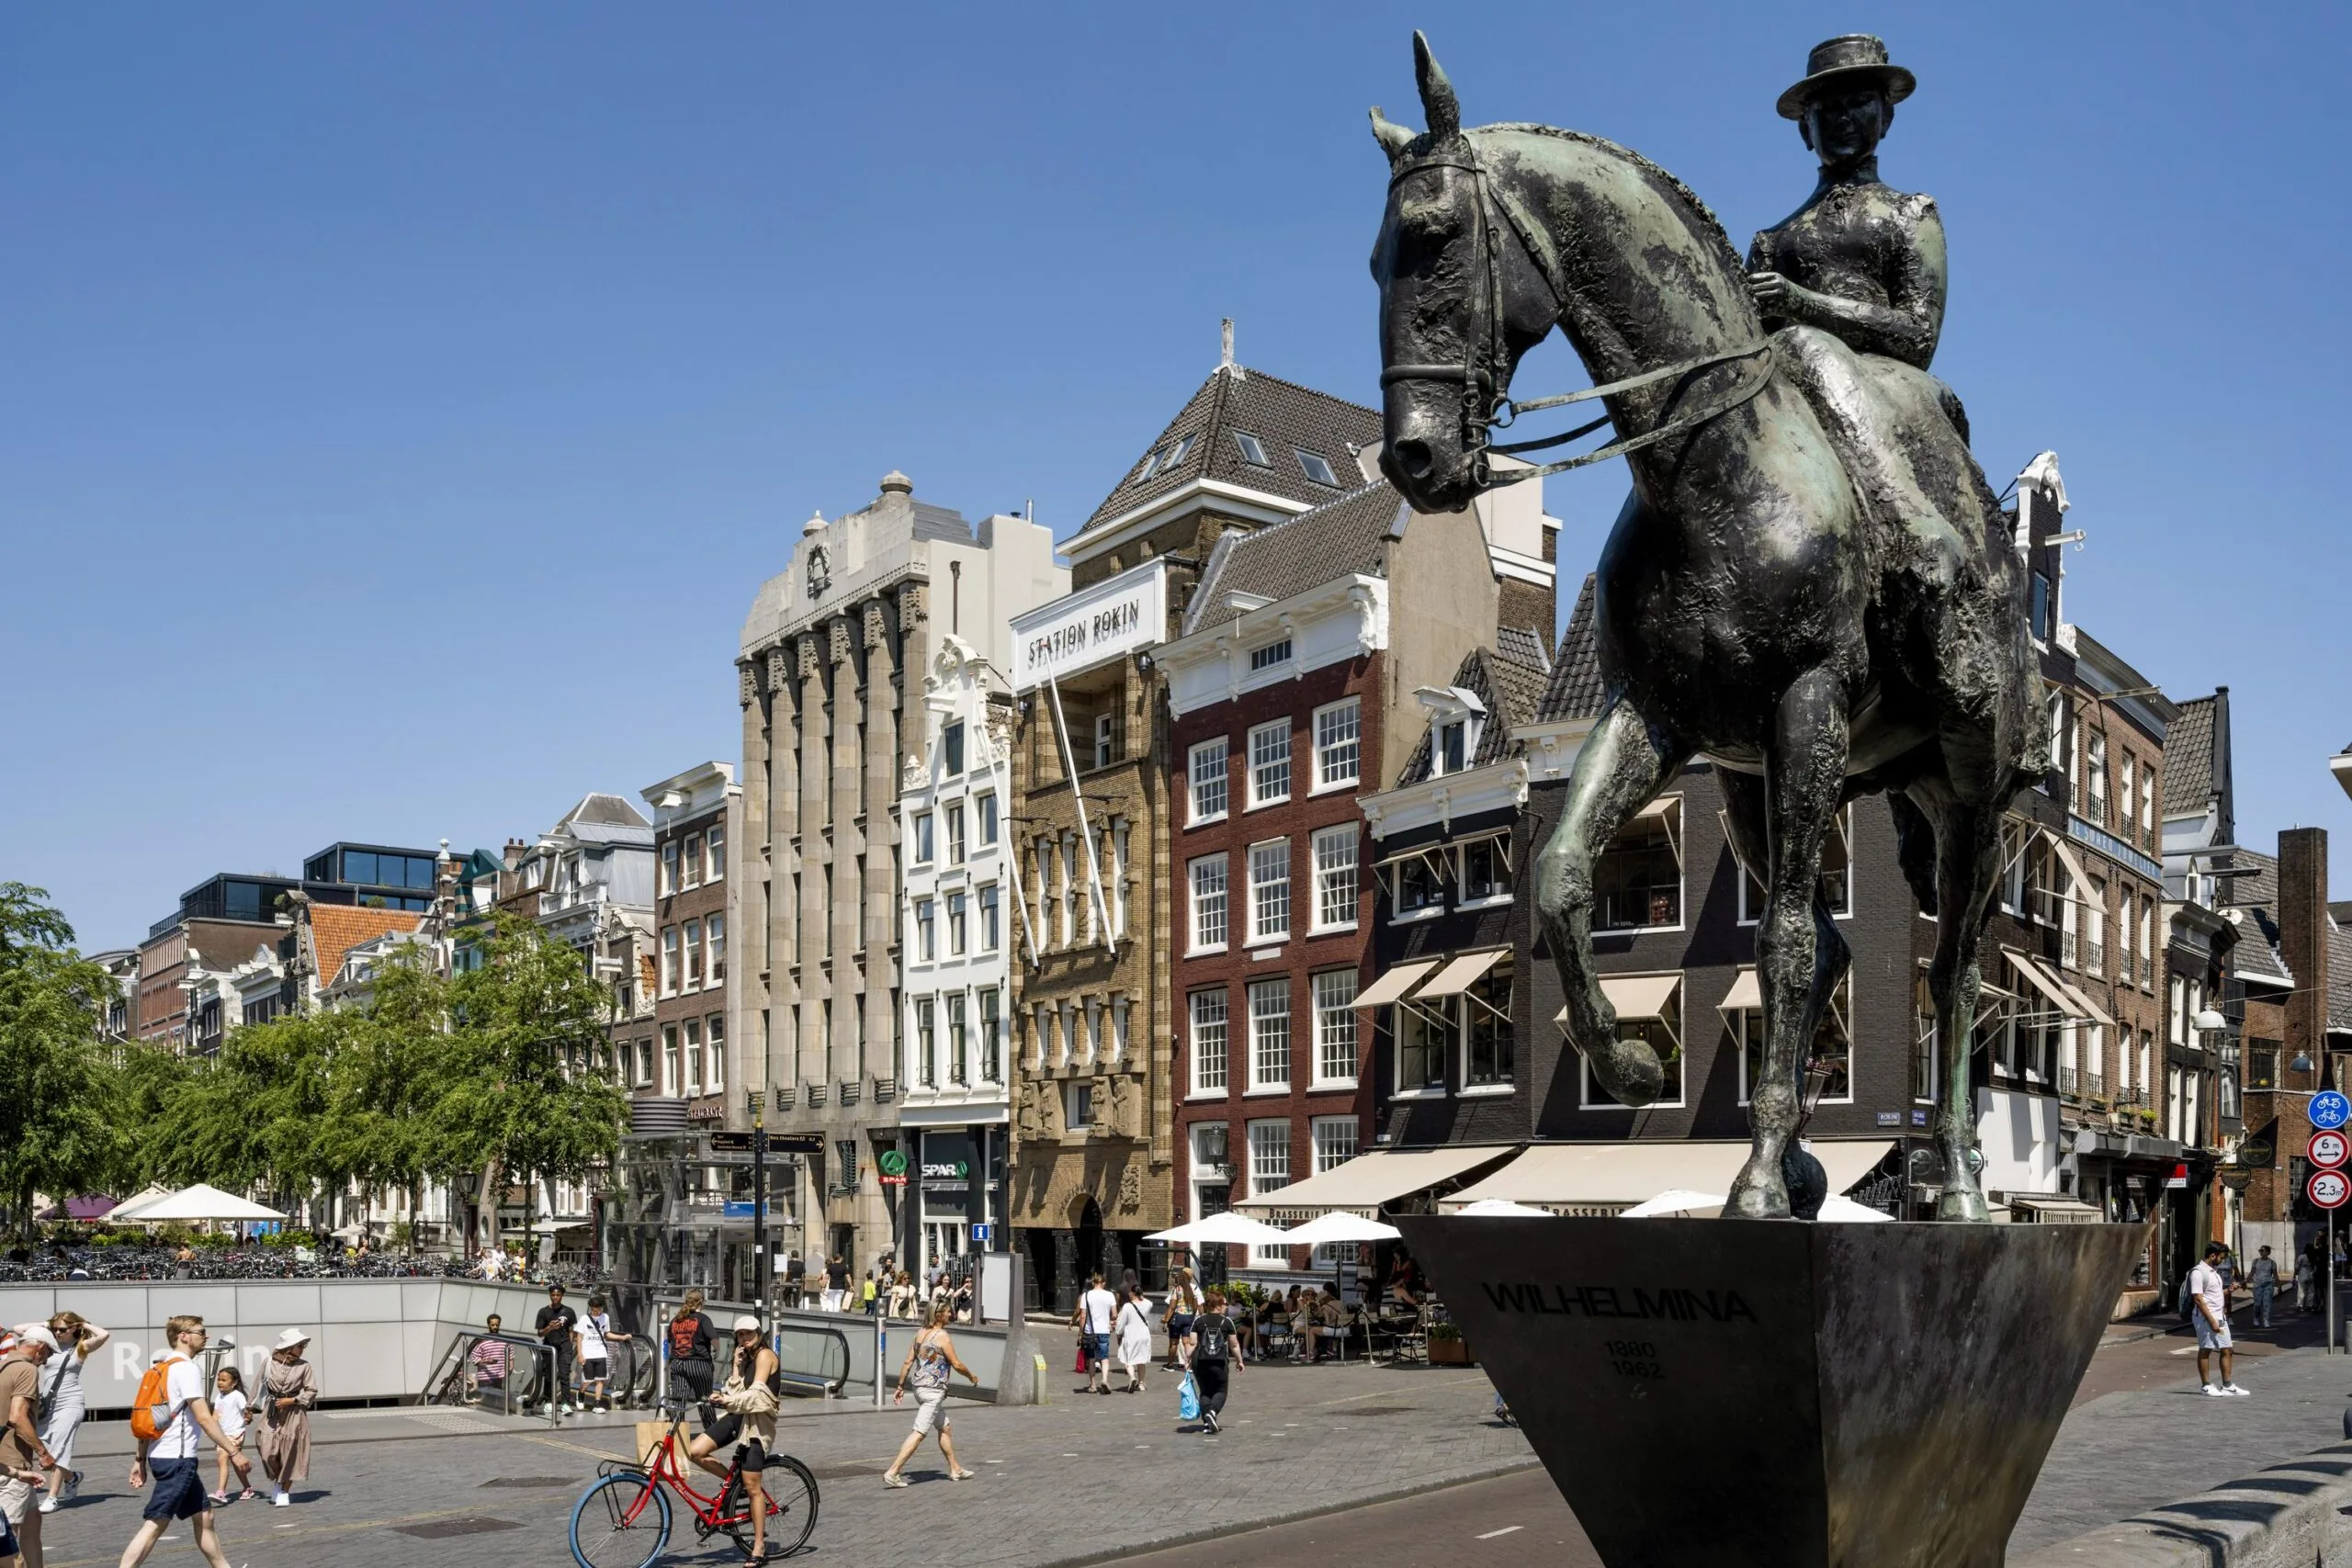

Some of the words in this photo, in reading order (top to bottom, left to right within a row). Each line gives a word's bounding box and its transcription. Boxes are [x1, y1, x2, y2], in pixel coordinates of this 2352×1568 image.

[1029, 620, 1087, 661] STATION
[1093, 599, 1139, 636] ROKIN
[2321, 1138, 2329, 1149] 6
[922, 1164, 956, 1177] SPAR
[1270, 1208, 1319, 1219] BRASSERIE
[1481, 1282, 1759, 1324] WILHELMINA
[1605, 1340, 1656, 1358] 1880
[1612, 1360, 1665, 1379] 1962
